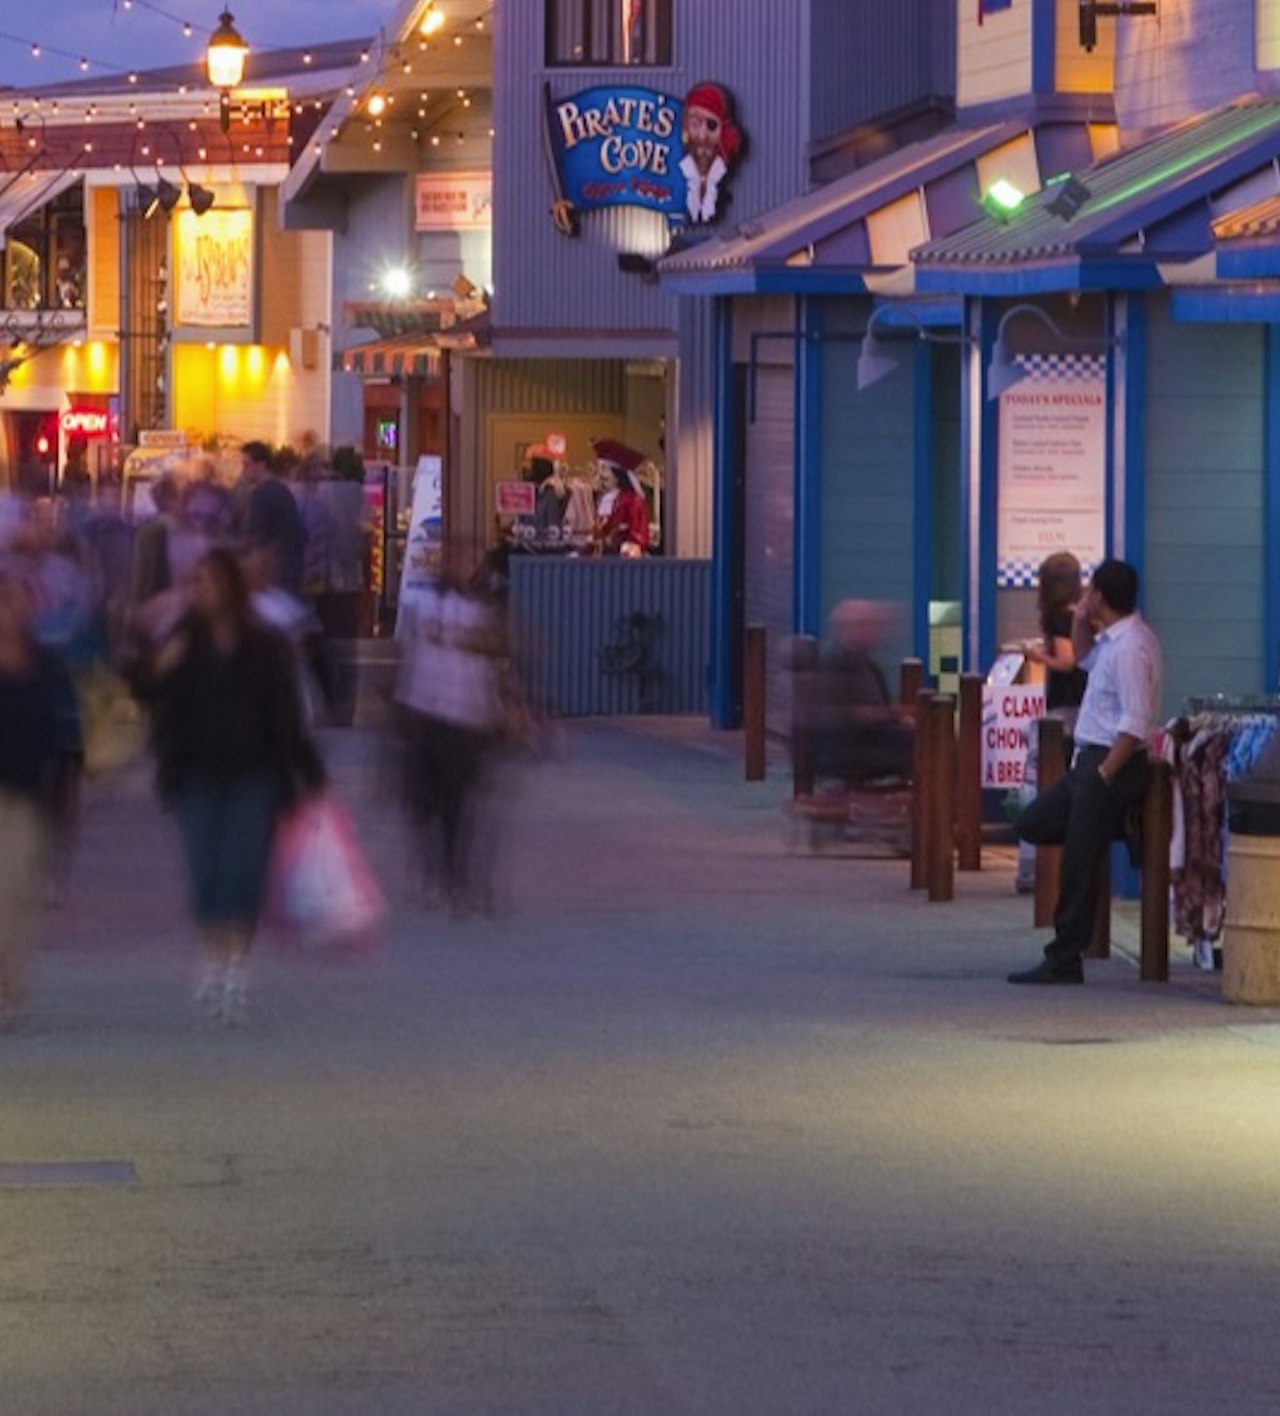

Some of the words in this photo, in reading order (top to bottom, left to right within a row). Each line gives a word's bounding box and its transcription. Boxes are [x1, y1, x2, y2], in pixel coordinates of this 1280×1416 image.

[557, 95, 676, 149] PIRATE'S
[599, 137, 670, 175] COVE
[61, 413, 108, 432] OPEN
[1002, 695, 1046, 717] CLAM
[985, 761, 995, 783] A
